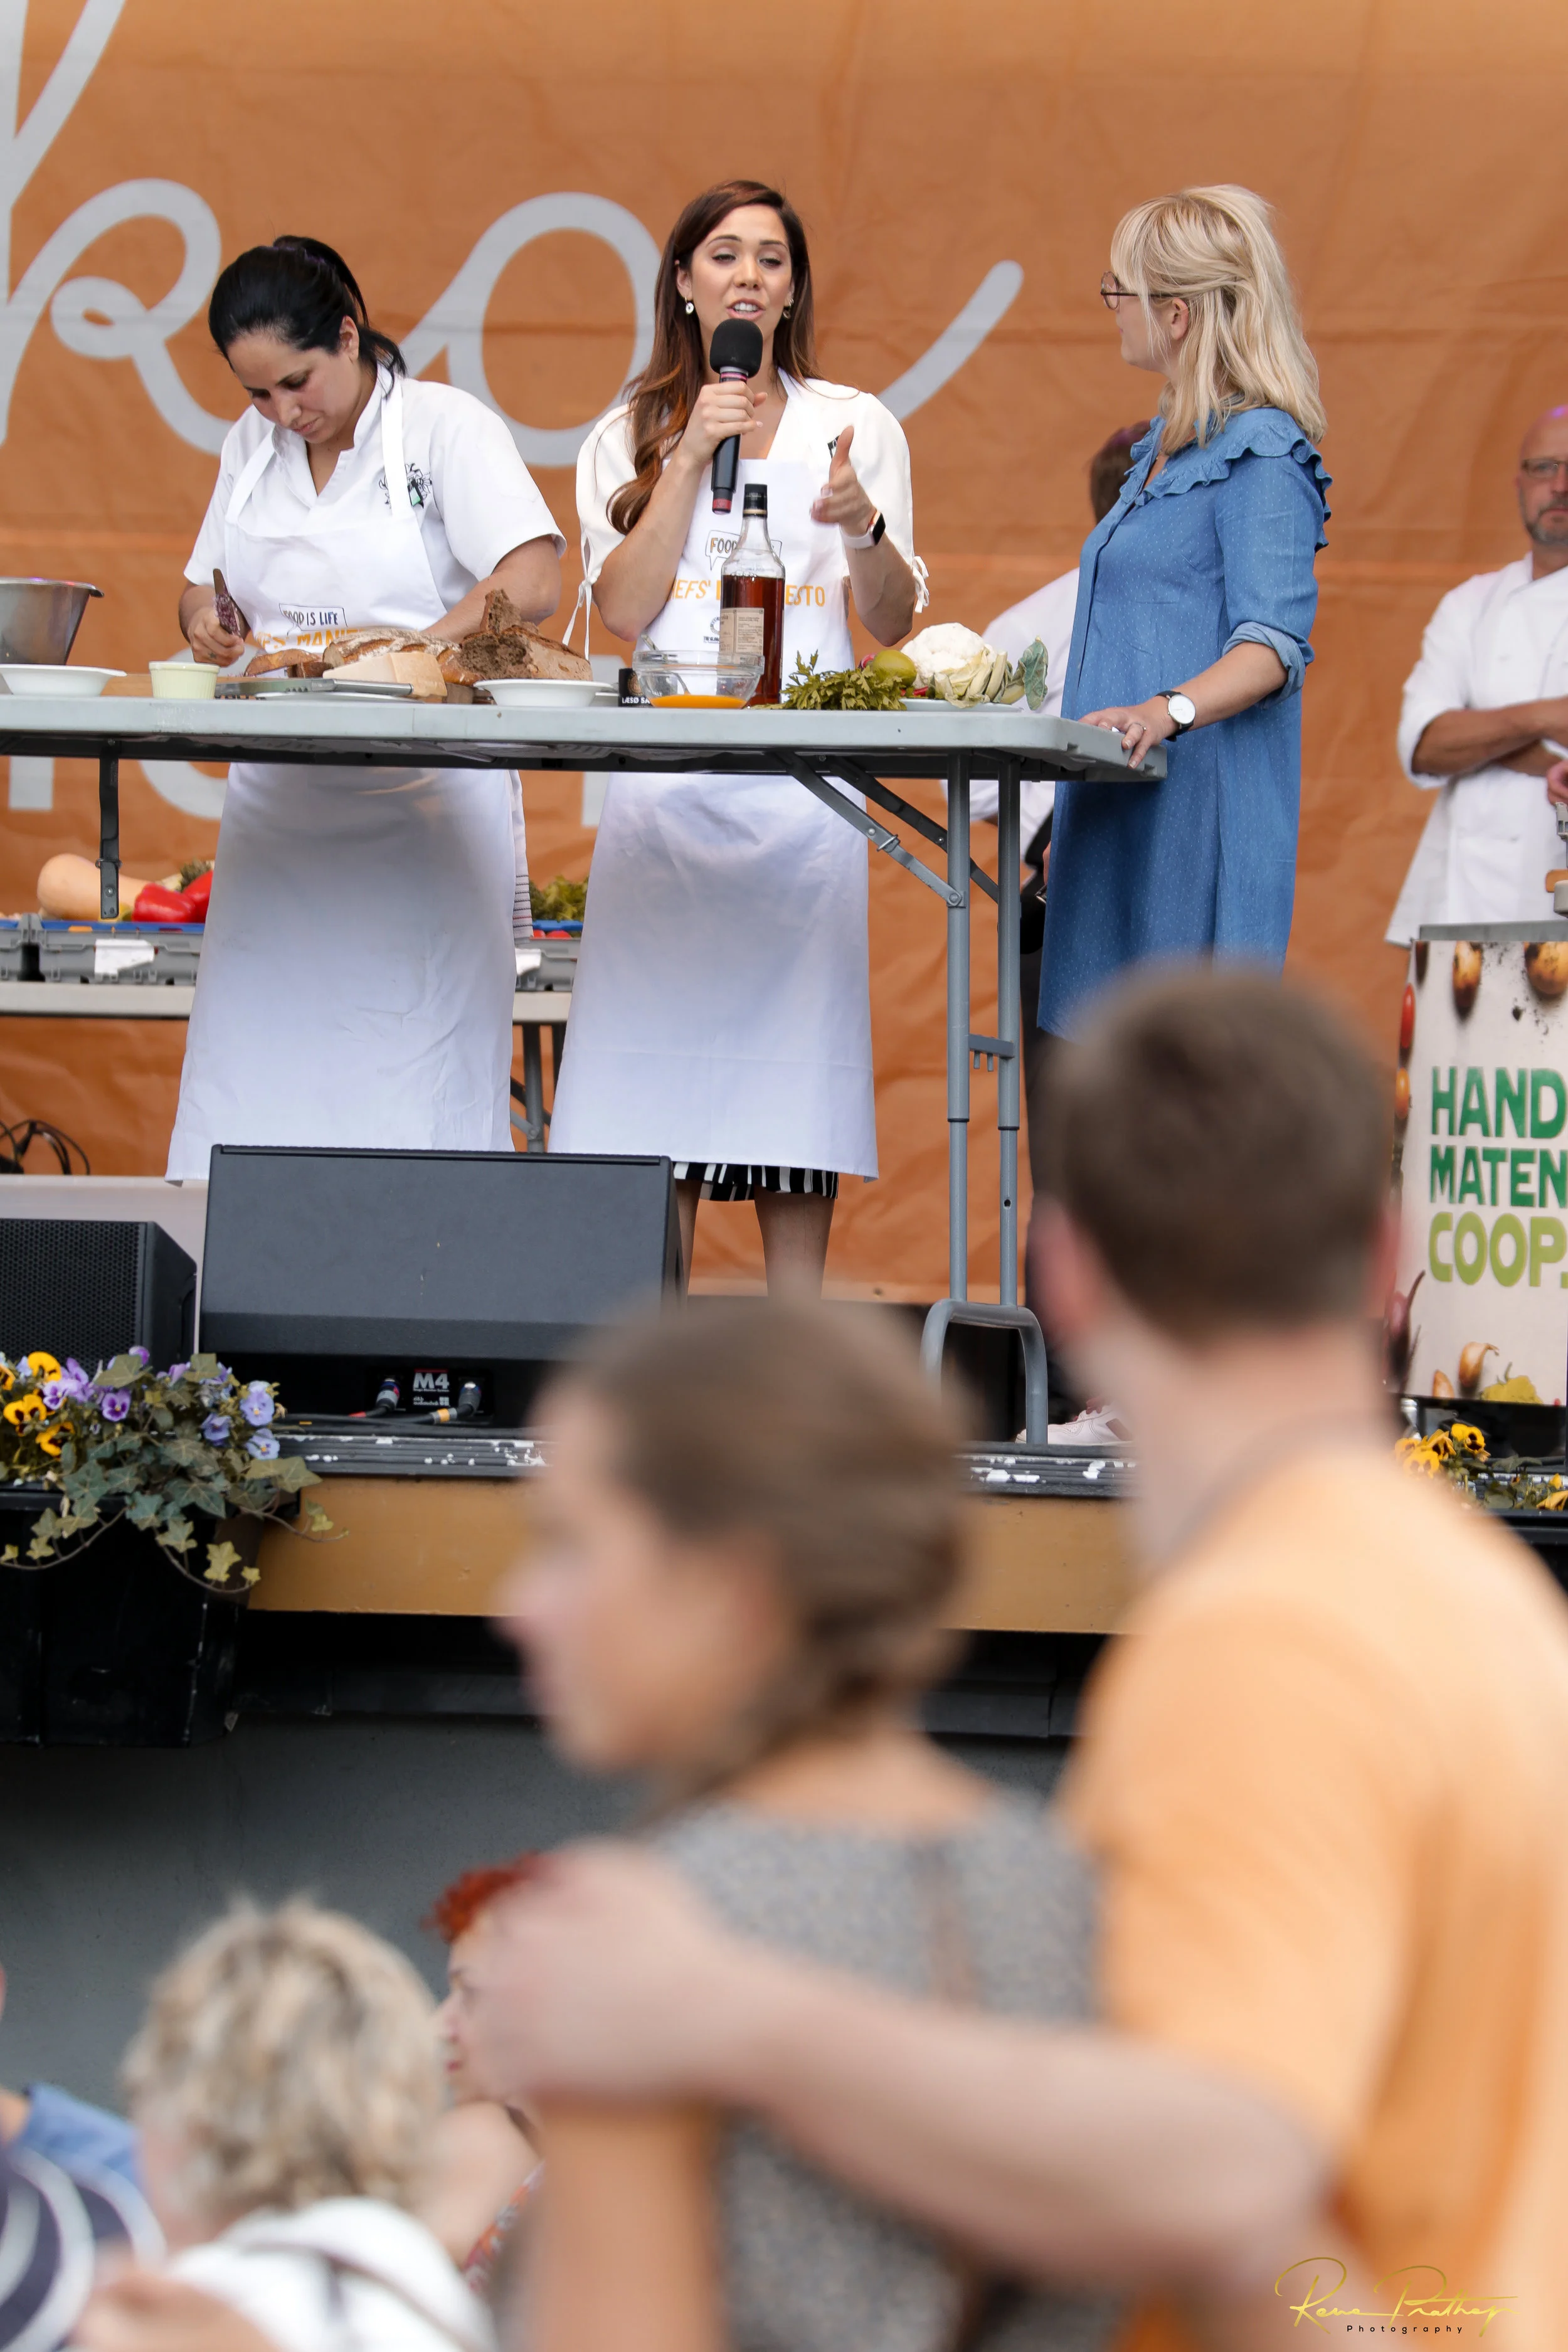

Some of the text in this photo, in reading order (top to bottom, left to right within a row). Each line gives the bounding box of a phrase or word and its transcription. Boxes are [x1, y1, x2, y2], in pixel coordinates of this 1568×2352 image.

[307, 612, 316, 626] IS
[319, 612, 339, 626] LIFE
[1432, 1065, 1567, 1138] HAND
[1430, 1144, 1568, 1209] MATEN
[1429, 1211, 1568, 1288] COOP.
[413, 1372, 450, 1389] M4
